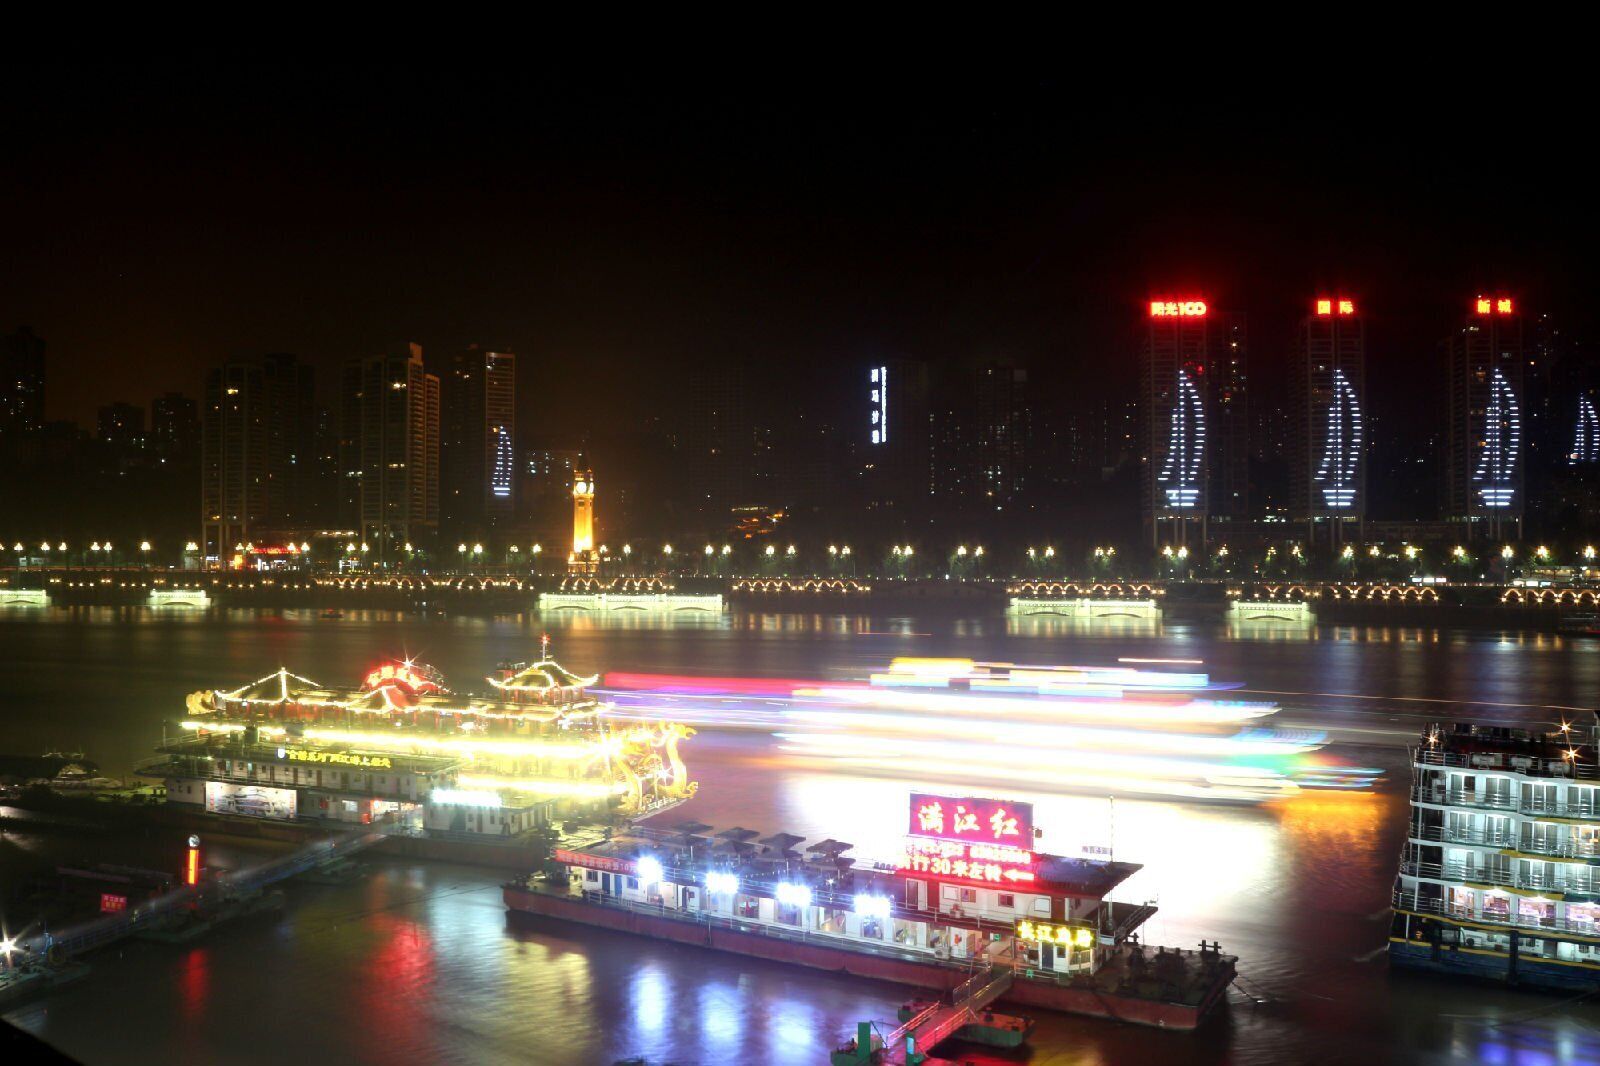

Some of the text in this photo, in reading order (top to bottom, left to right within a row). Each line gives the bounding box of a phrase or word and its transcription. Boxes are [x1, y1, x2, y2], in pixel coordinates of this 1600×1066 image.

[1151, 301, 1207, 316] 阳光100
[1317, 300, 1354, 315] 国际
[1477, 299, 1512, 314] 新城
[917, 801, 1020, 839] 满江红
